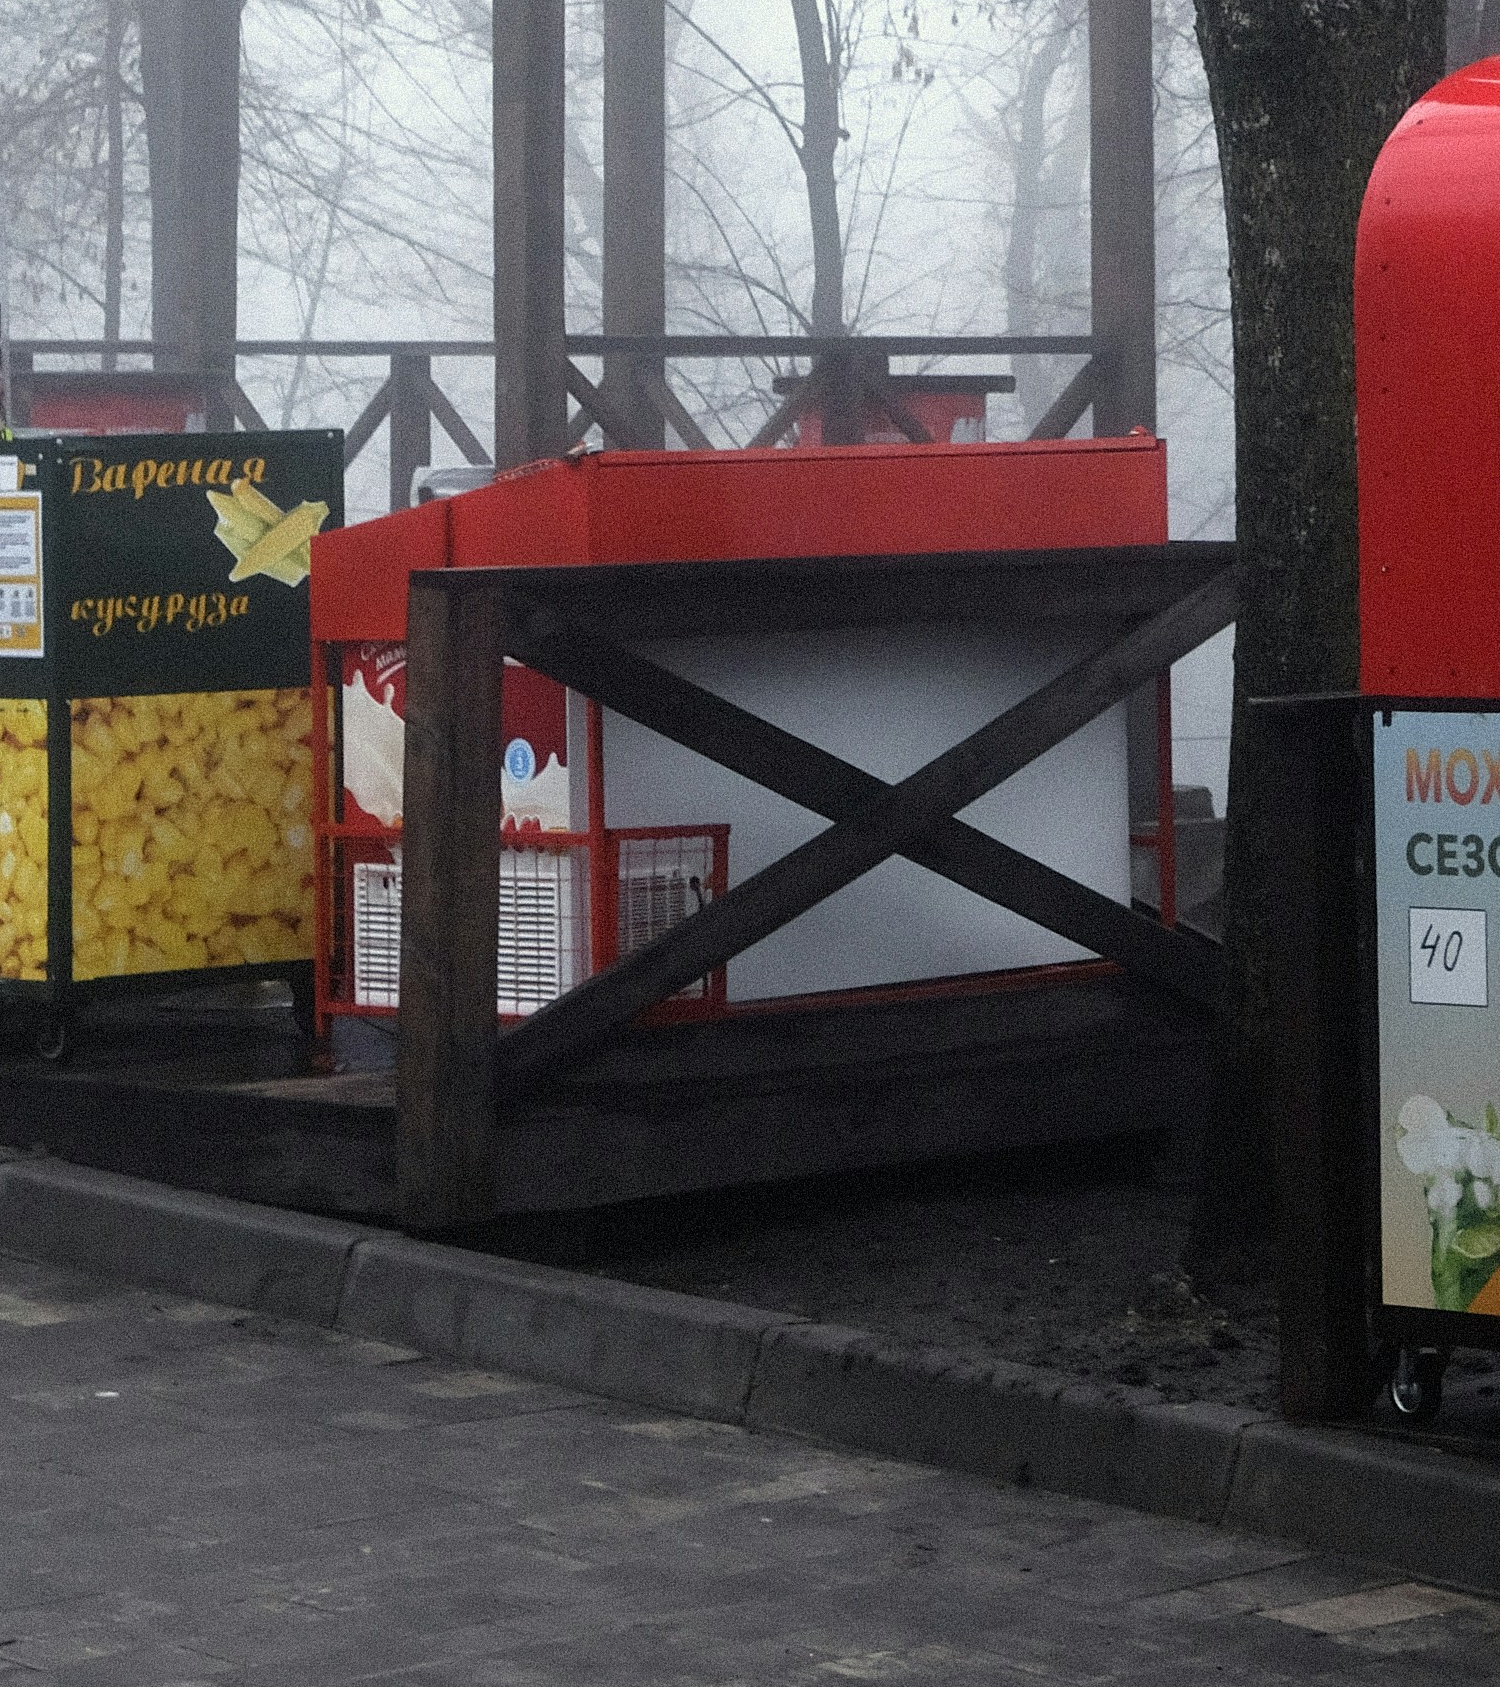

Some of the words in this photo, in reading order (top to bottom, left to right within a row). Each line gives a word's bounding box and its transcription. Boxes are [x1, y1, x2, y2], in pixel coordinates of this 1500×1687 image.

[70, 457, 266, 500] Вареная
[70, 593, 249, 636] кукуруза
[1420, 924, 1463, 972] 40
